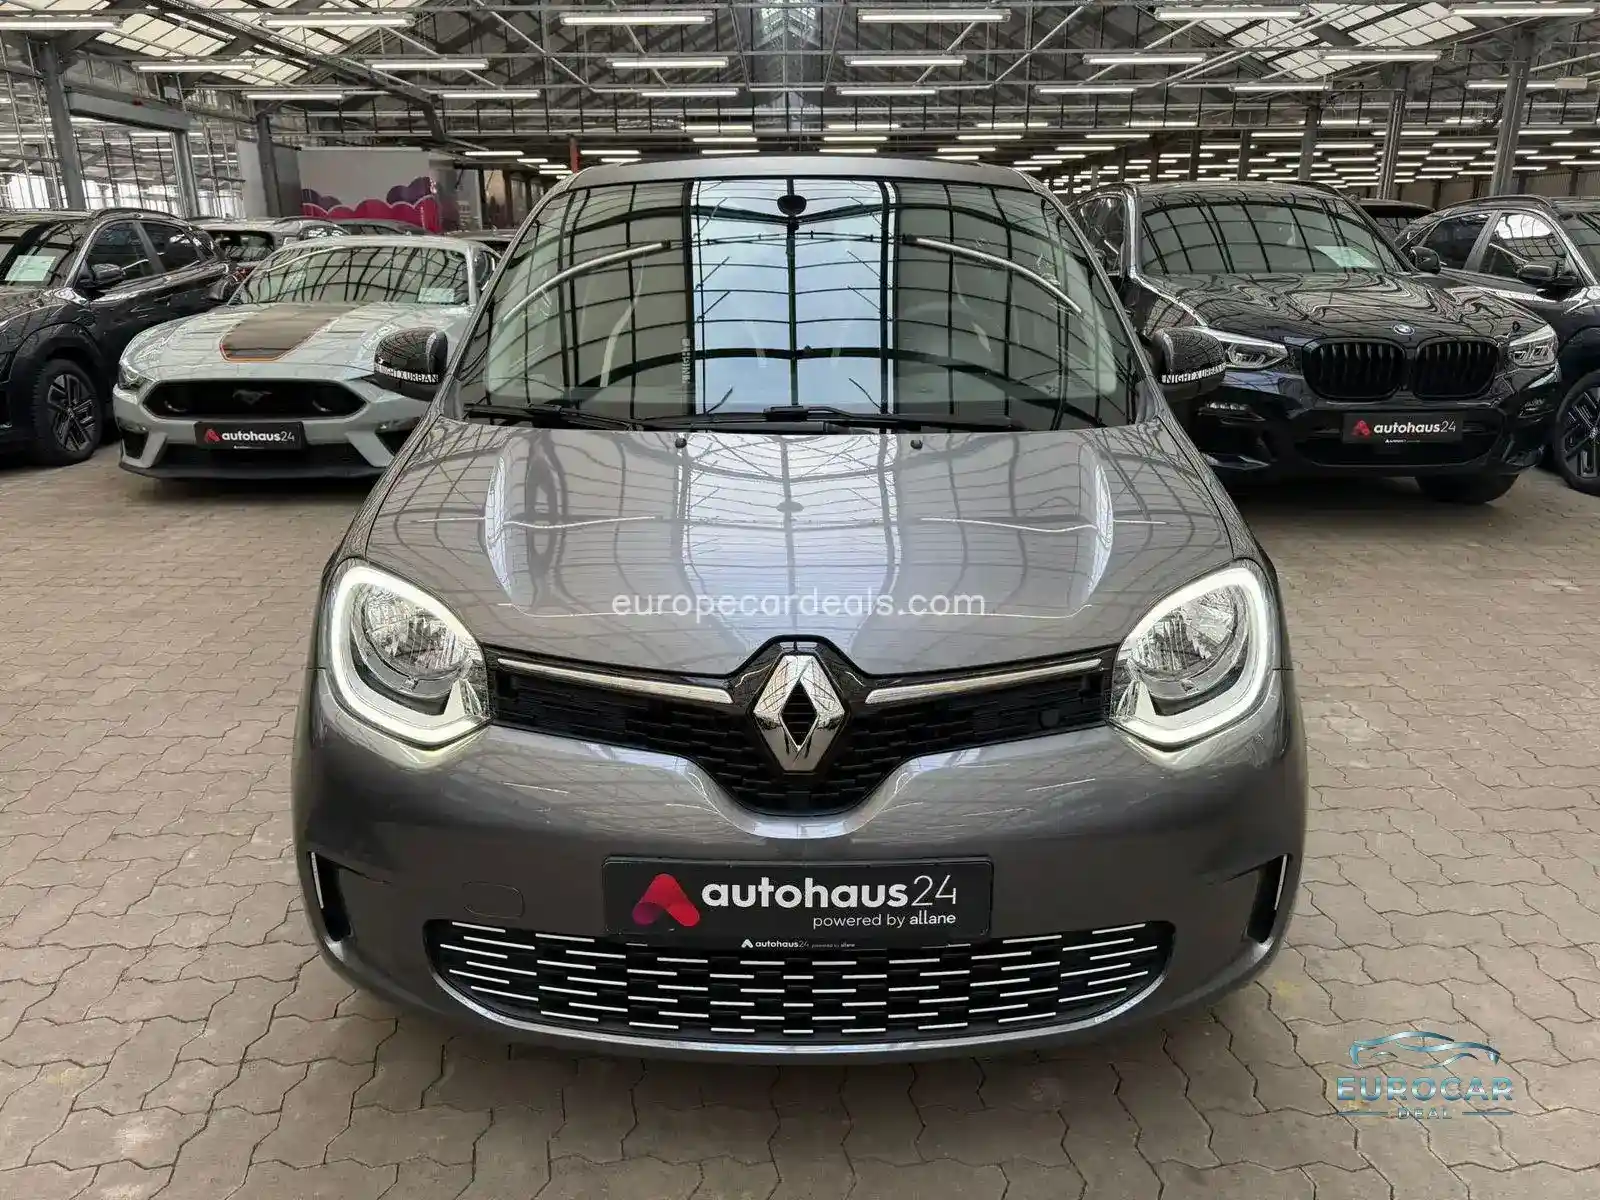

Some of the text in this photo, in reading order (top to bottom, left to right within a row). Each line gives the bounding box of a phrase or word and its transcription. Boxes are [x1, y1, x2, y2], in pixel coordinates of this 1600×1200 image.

[1373, 420, 1456, 433] autohaus24
[221, 431, 295, 442] autohaus24
[701, 874, 957, 908] autohaus24
[812, 909, 956, 929] powered by allane
[755, 940, 810, 948] autohaus24
